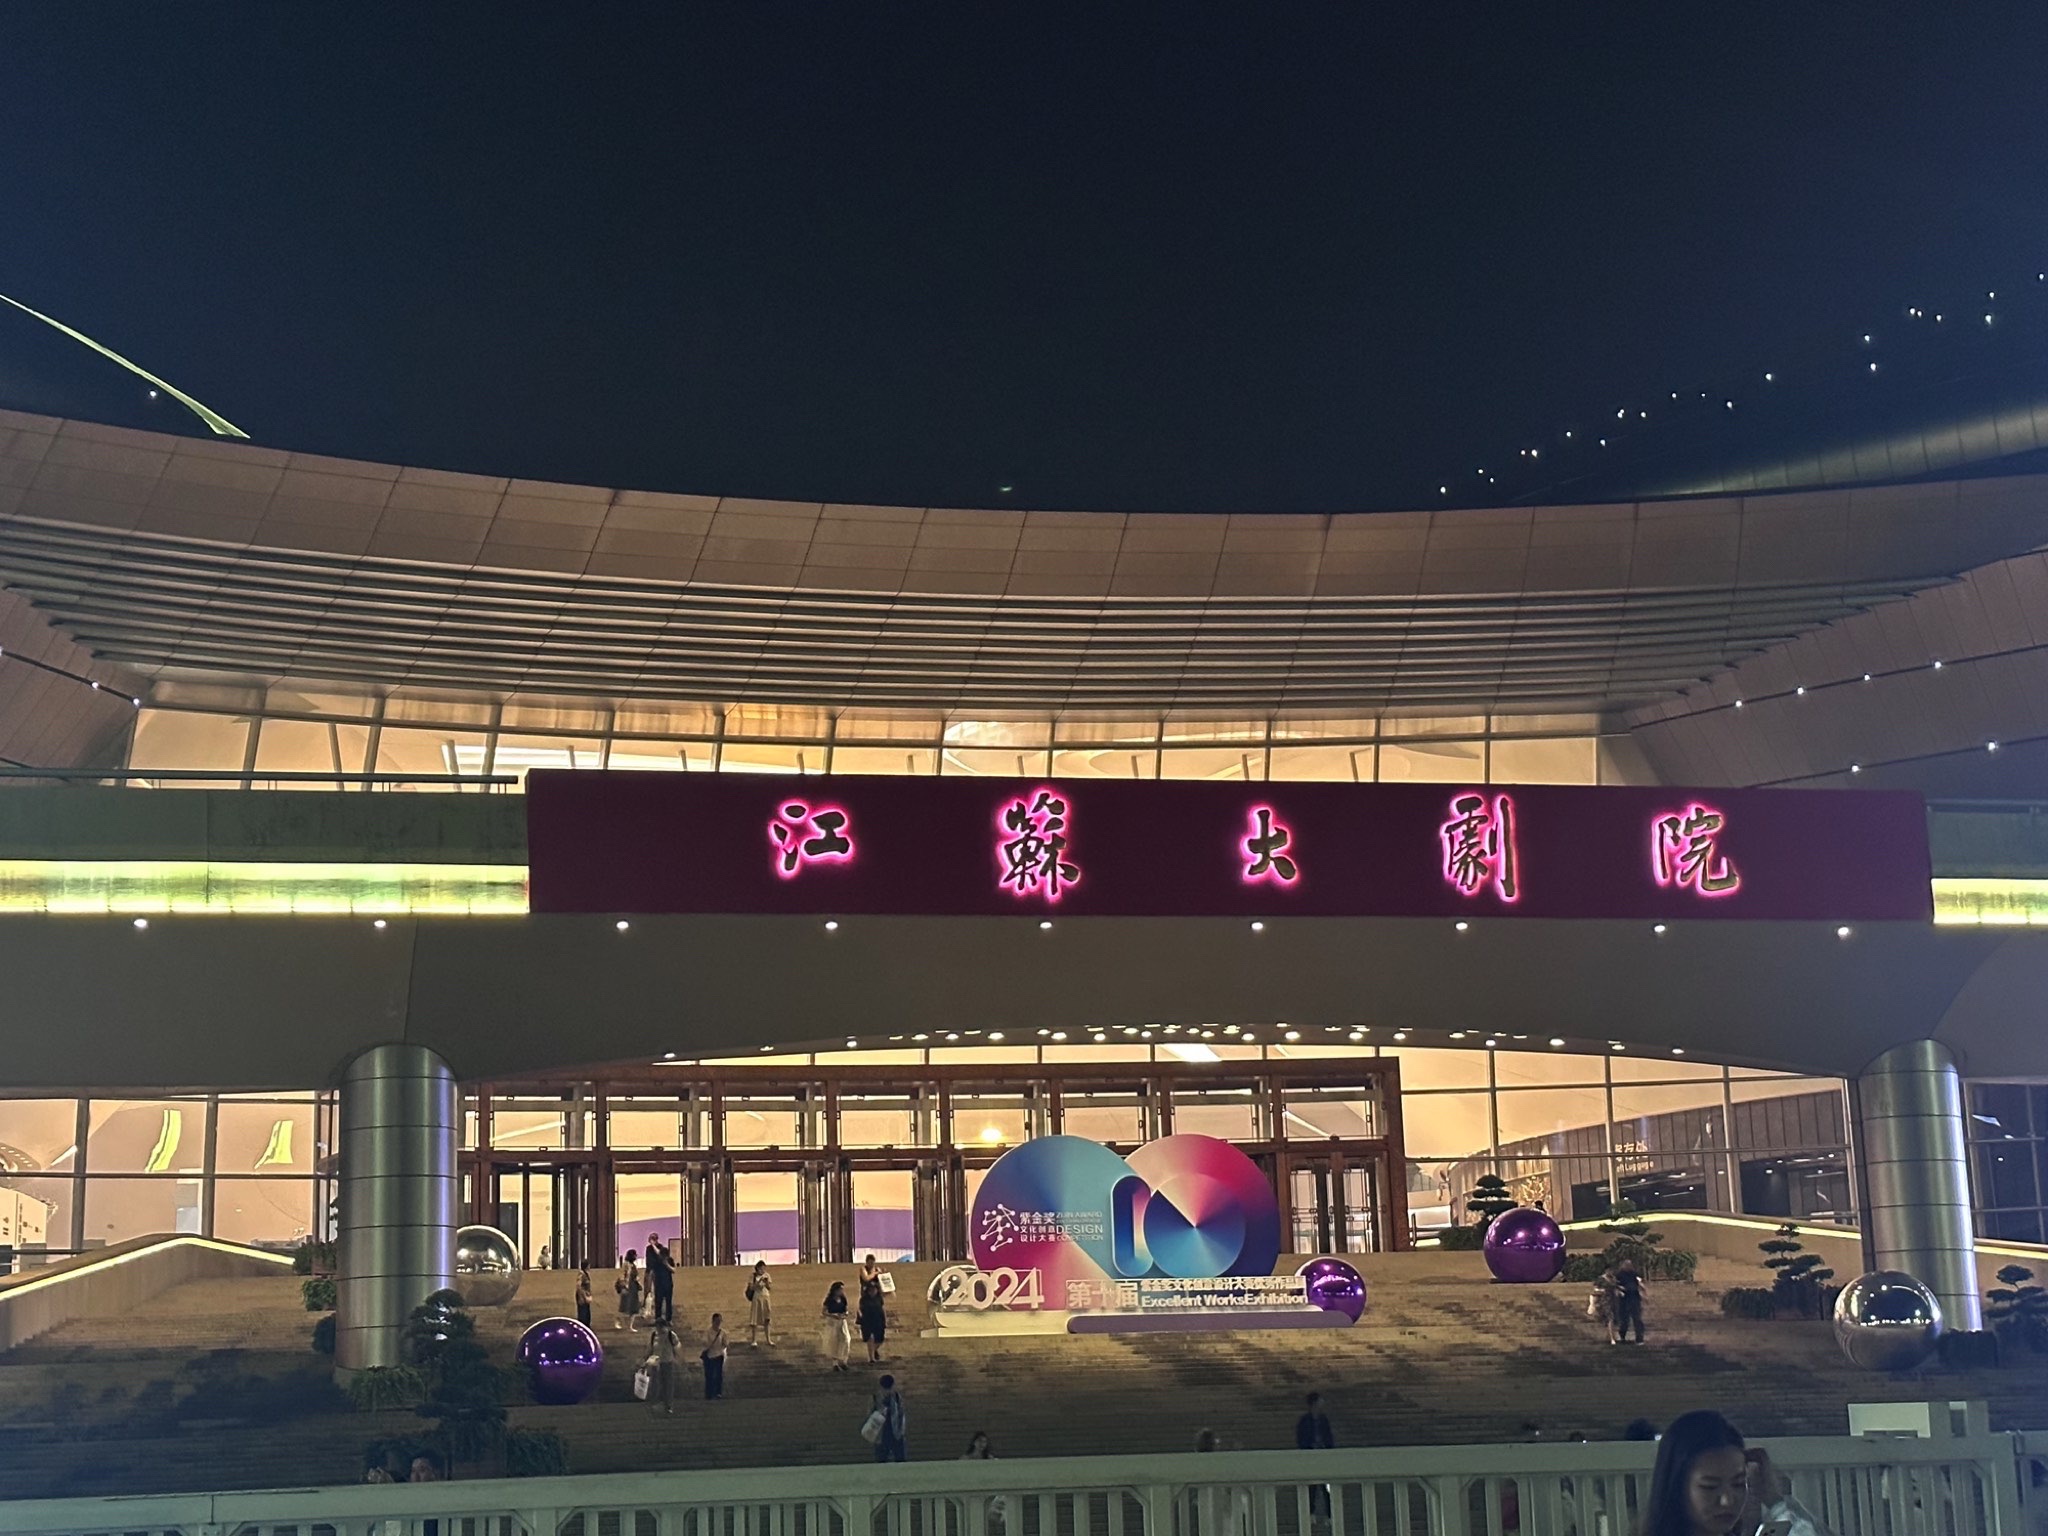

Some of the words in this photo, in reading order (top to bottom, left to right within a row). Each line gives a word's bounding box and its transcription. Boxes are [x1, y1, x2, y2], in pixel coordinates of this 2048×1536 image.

[1020, 1211, 1055, 1225] 紫金奖
[1056, 1224, 1103, 1234] DESIGN
[1020, 1234, 1056, 1242] 设计大赛
[941, 1267, 1045, 1310] 2024
[1141, 1294, 1202, 1308] Excellent
